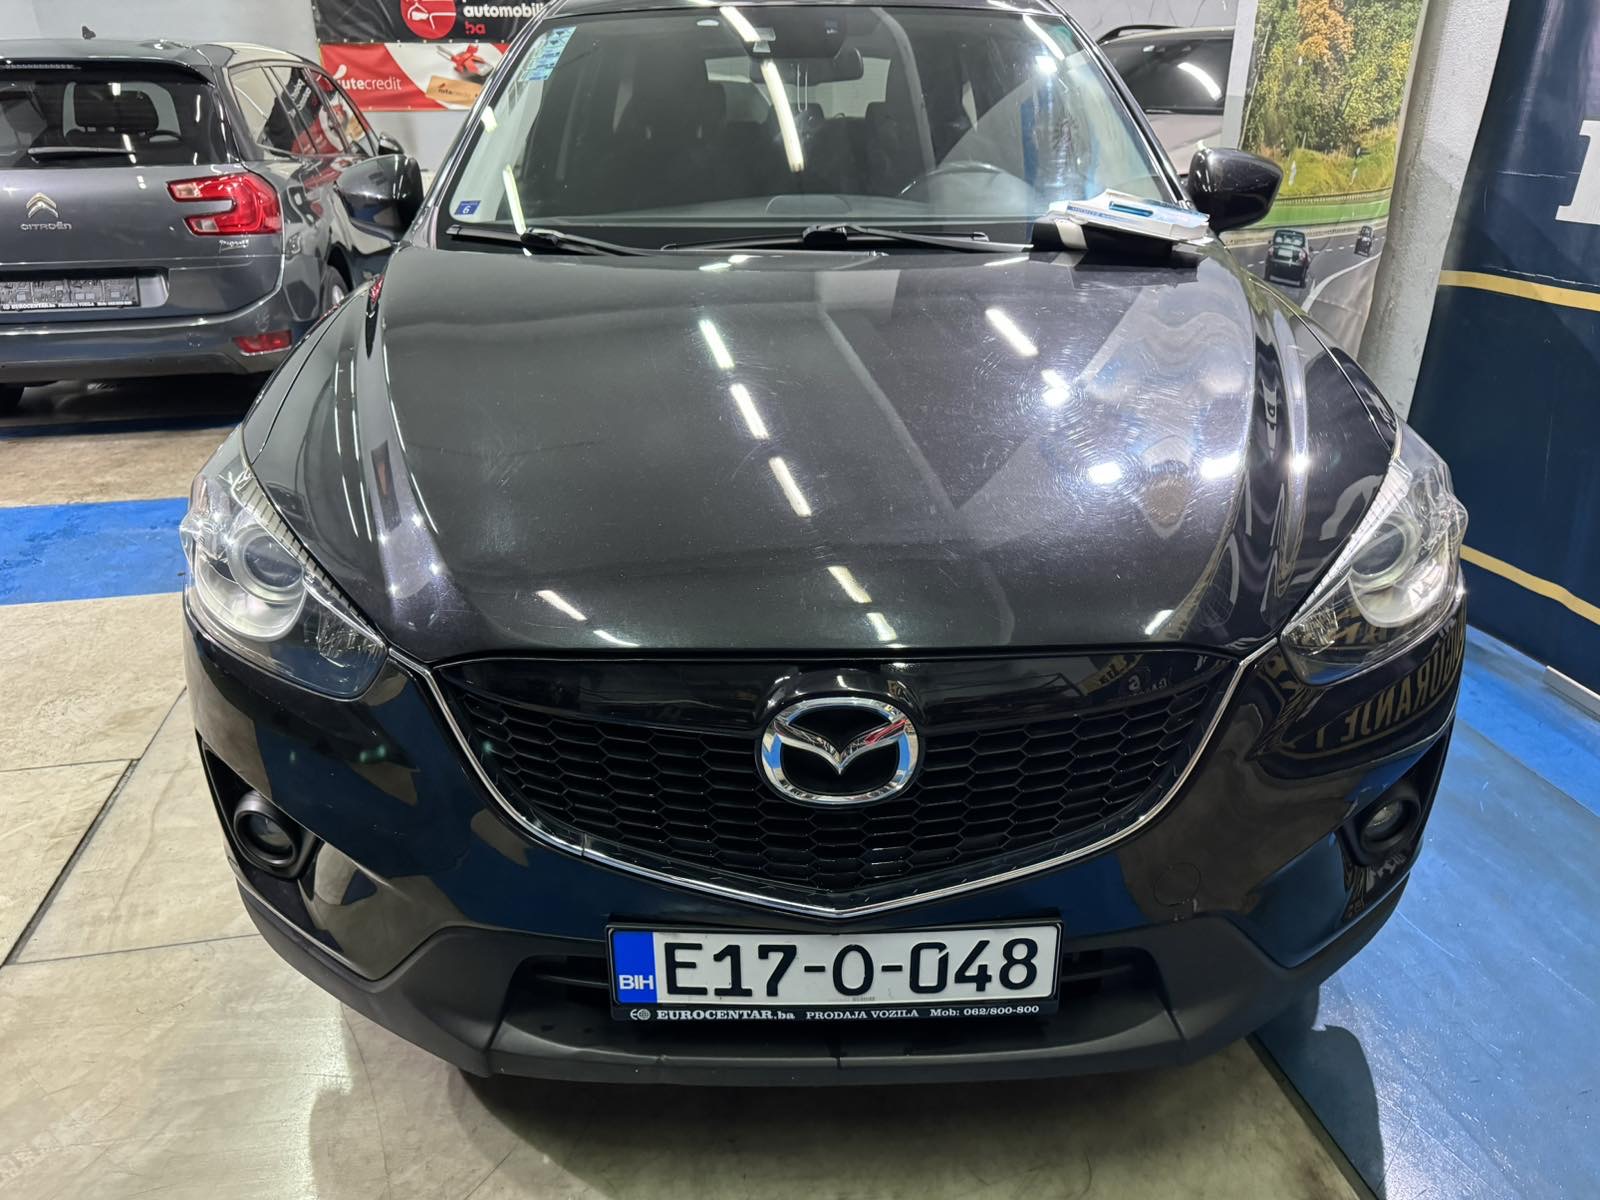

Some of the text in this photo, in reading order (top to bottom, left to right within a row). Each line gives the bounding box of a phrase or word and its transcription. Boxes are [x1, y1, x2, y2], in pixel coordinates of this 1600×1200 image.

[619, 974, 654, 990] BIH
[656, 1005, 1039, 1020] EUROCENTAR.ba PRODAJA VOZILA Mob: 062/800-800
